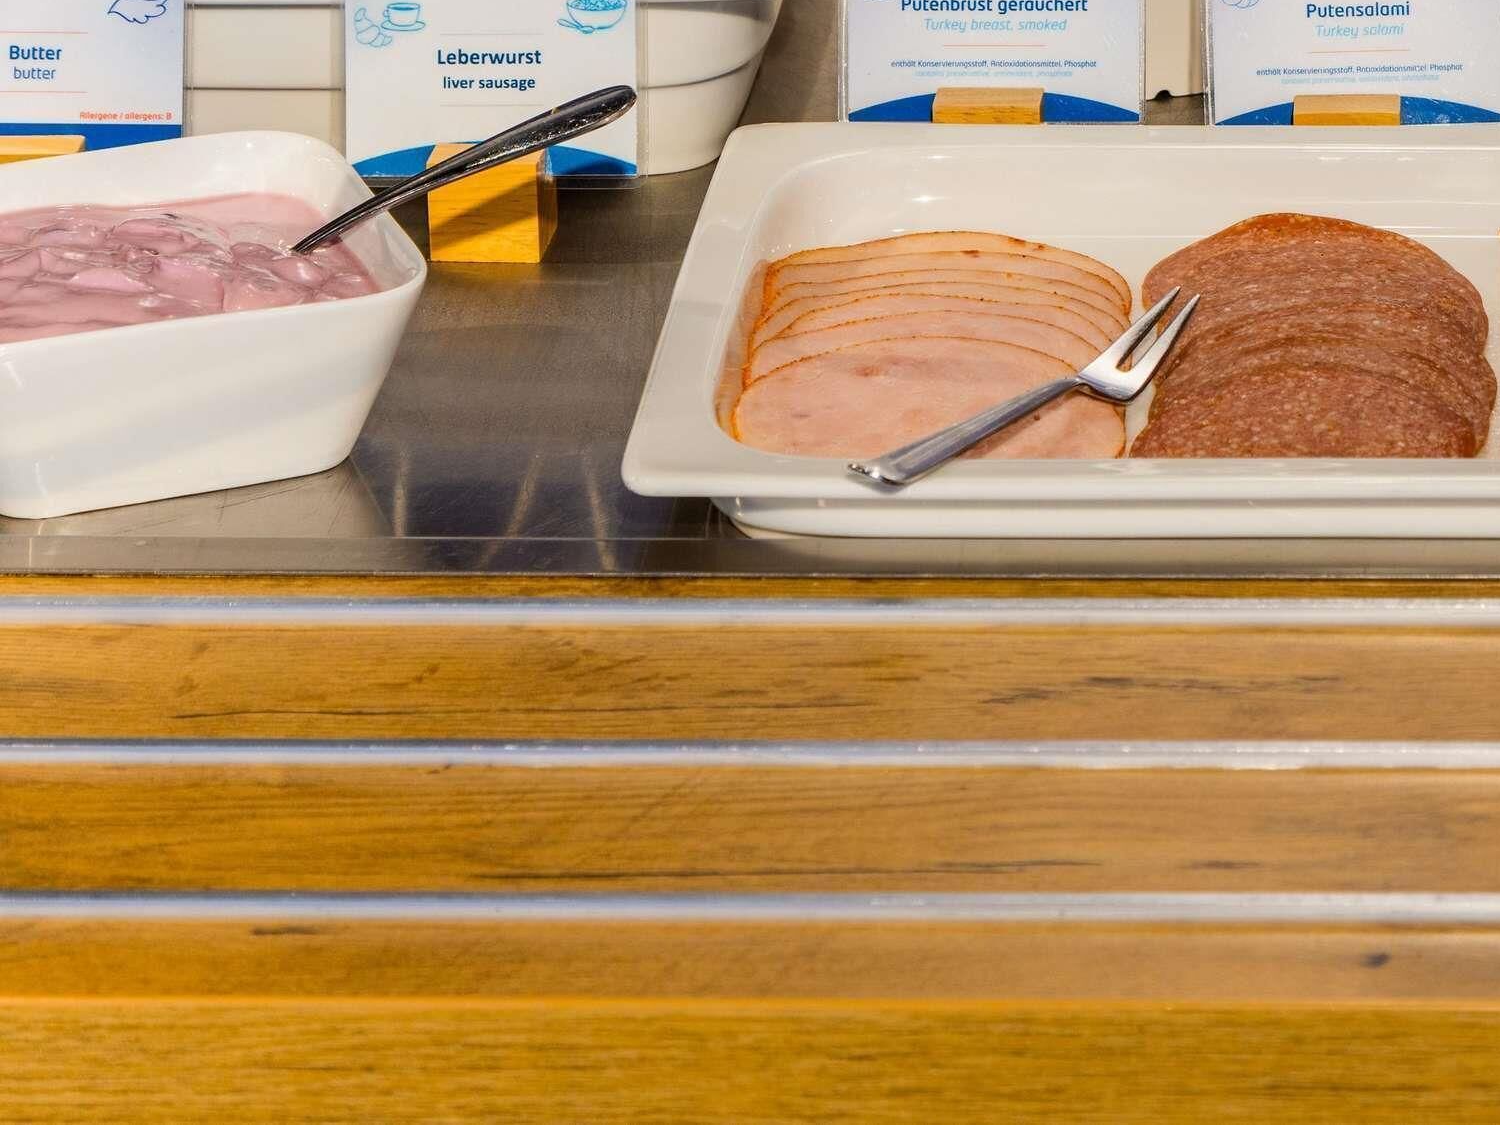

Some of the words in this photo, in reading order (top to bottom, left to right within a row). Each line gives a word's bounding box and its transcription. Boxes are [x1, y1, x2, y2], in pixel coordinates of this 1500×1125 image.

[1306, 1, 1410, 19] Putensalami
[924, 18, 966, 33] Turkey
[1017, 18, 1068, 31] smoked
[1314, 24, 1358, 39] Turkey
[1363, 22, 1405, 36] salami
[9, 45, 62, 60] Butter
[437, 49, 541, 65] Leberwurst
[13, 66, 56, 80] butter
[443, 76, 475, 89] liver
[478, 78, 536, 92] sausage
